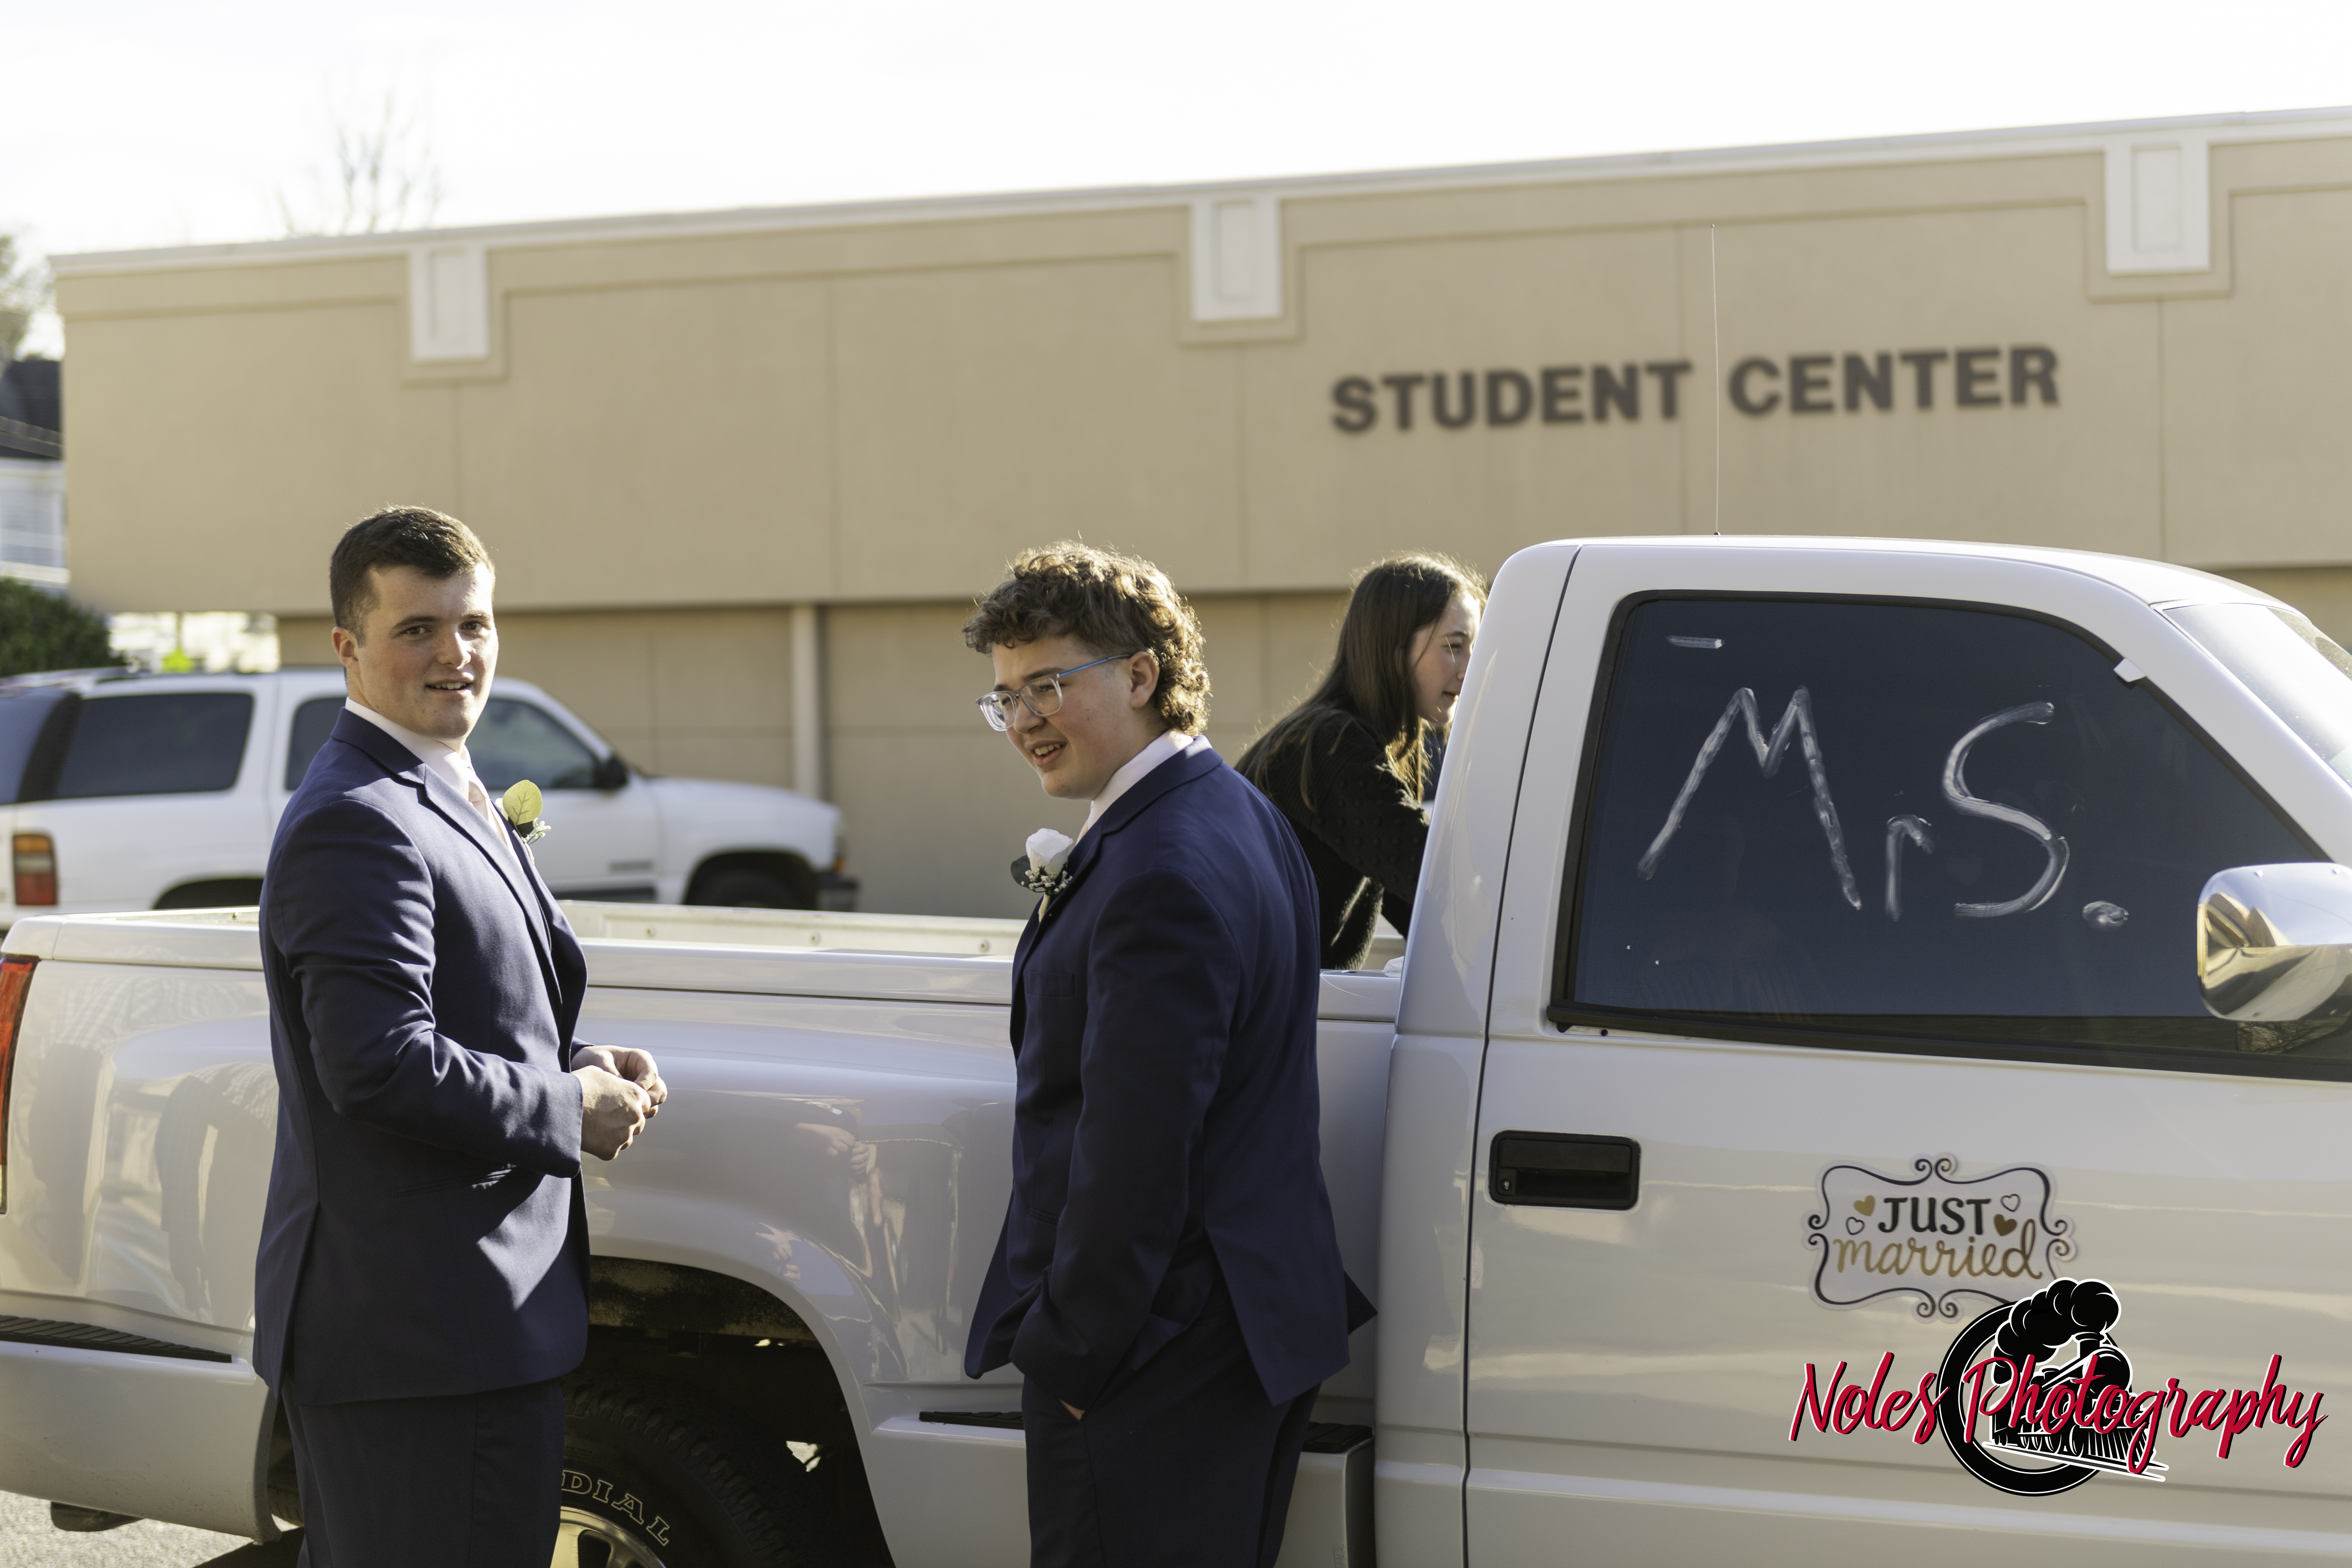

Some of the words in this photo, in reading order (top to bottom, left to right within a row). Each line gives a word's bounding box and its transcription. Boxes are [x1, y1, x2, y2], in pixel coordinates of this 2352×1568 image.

[1331, 360, 1693, 434] STUDENT
[1728, 345, 2060, 418] CENTER
[1832, 1218, 2043, 1280] married
[1877, 1197, 1992, 1235] JUST
[561, 1469, 670, 1546] DIAL
